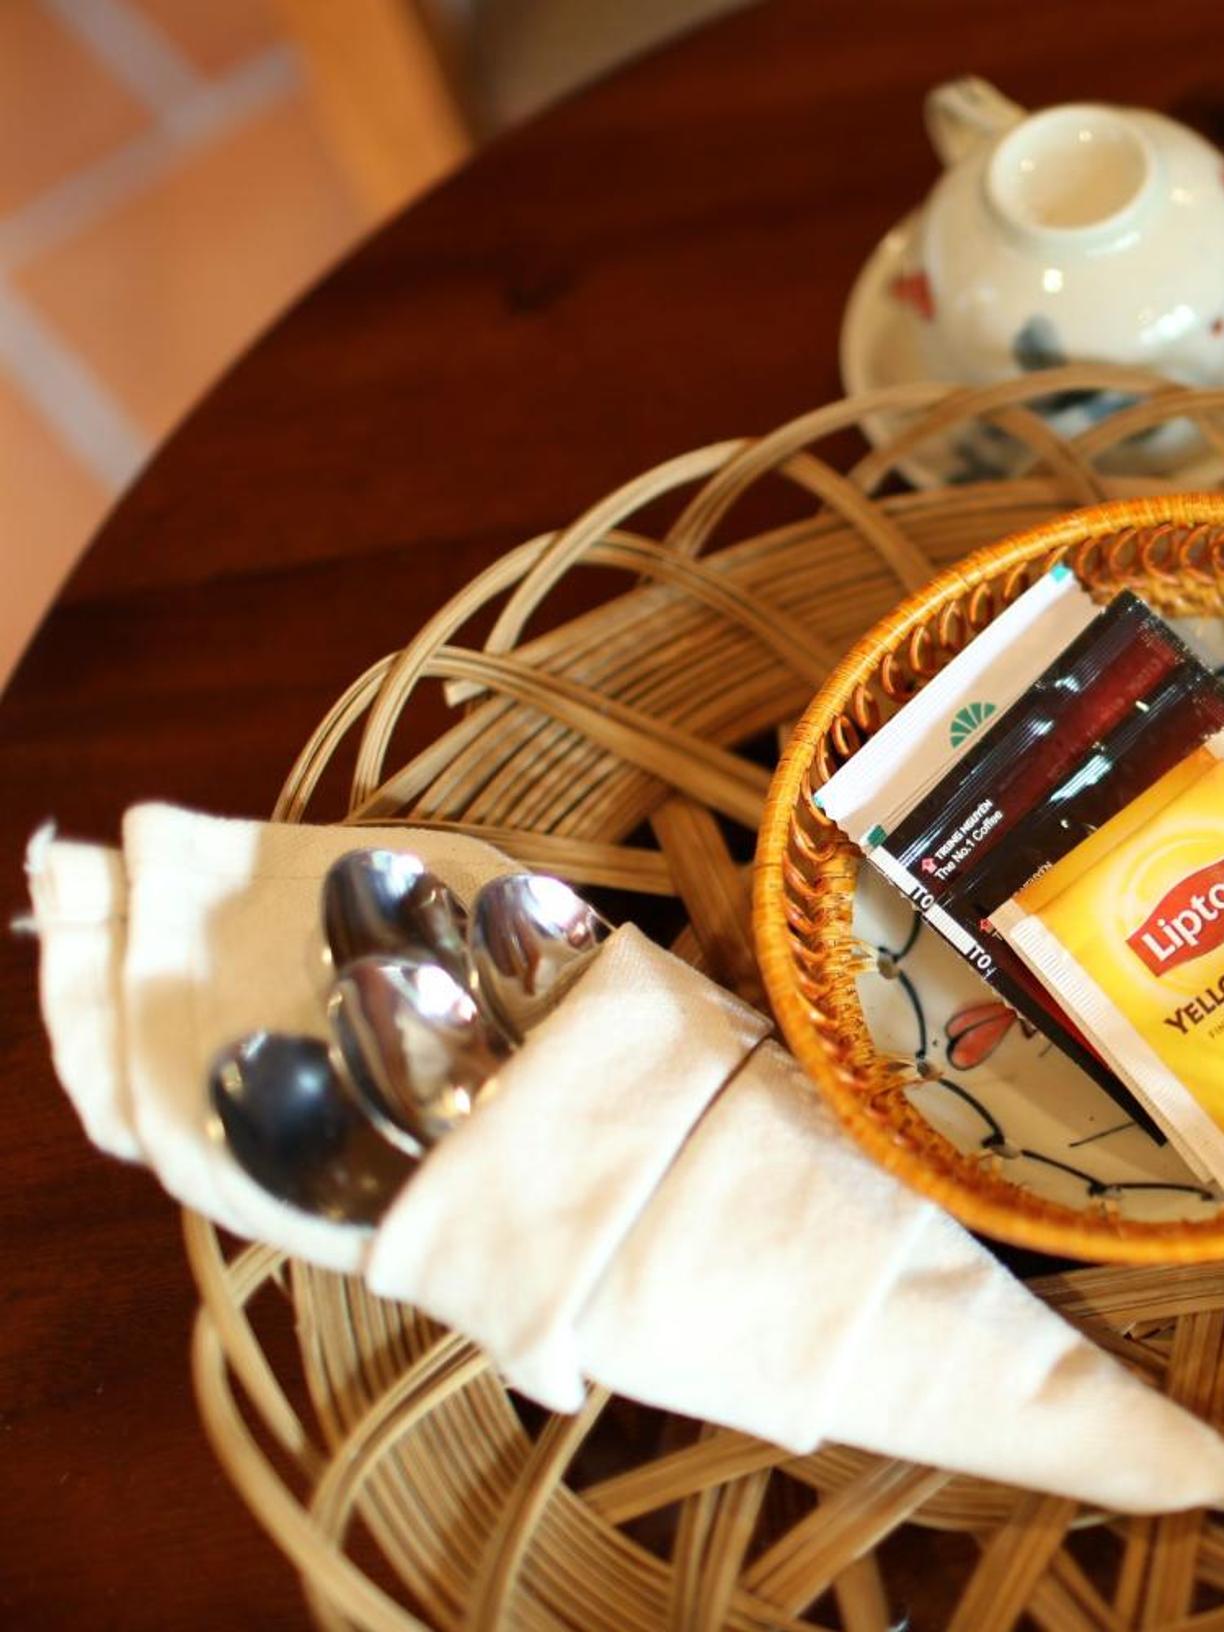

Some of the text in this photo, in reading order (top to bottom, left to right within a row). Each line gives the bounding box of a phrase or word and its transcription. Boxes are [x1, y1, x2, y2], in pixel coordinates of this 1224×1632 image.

[934, 827, 962, 861] TRUNG
[934, 810, 1004, 881] The No.1 Coffee
